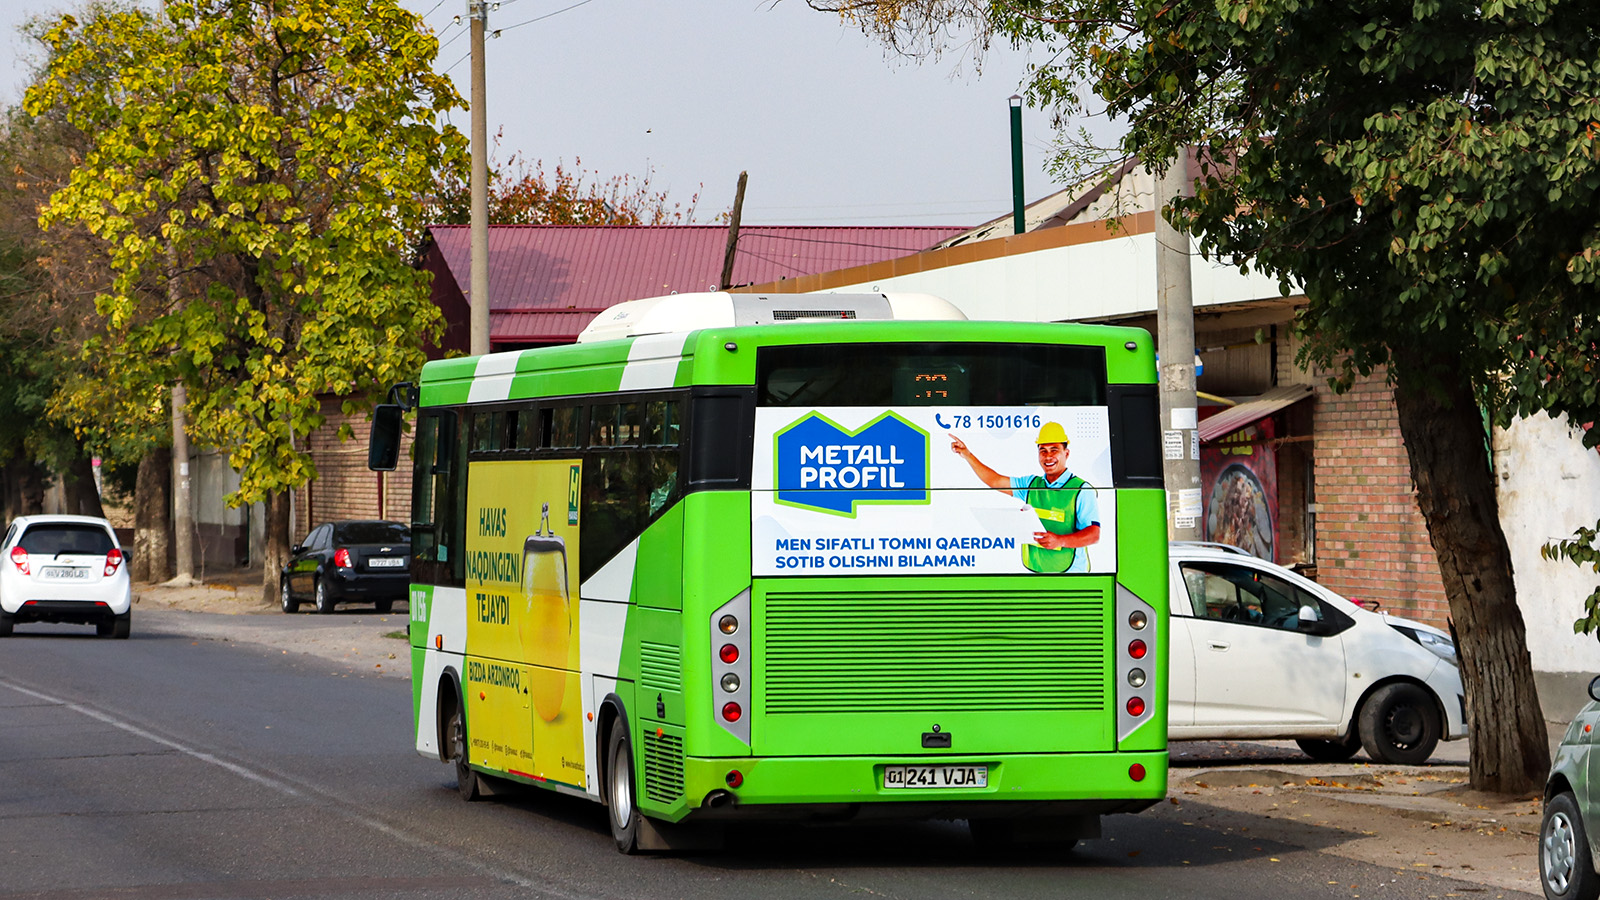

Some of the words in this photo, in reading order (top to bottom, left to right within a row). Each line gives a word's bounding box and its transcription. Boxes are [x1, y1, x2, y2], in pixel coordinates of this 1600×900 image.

[953, 415, 971, 429] 78
[977, 415, 1041, 429] 1501616
[800, 445, 904, 465] METALL
[800, 467, 904, 488] PROFIL
[479, 508, 506, 537] HAVAS
[775, 538, 811, 551] MEN
[815, 538, 875, 551] SIFATLI
[879, 537, 932, 550] TOMNI
[936, 537, 1015, 550] QAERDAN
[466, 550, 520, 586] NAQDINGIZNI
[775, 556, 824, 568] SOTIB
[829, 556, 894, 568] OLISHNI
[899, 555, 976, 568] BILAMAN!
[476, 593, 510, 625] TEJAYDI
[469, 661, 487, 683] BIZDA
[487, 664, 520, 694] ARZONROQ
[888, 770, 904, 783] 01
[907, 768, 937, 785] 241
[943, 768, 976, 785] VJA
